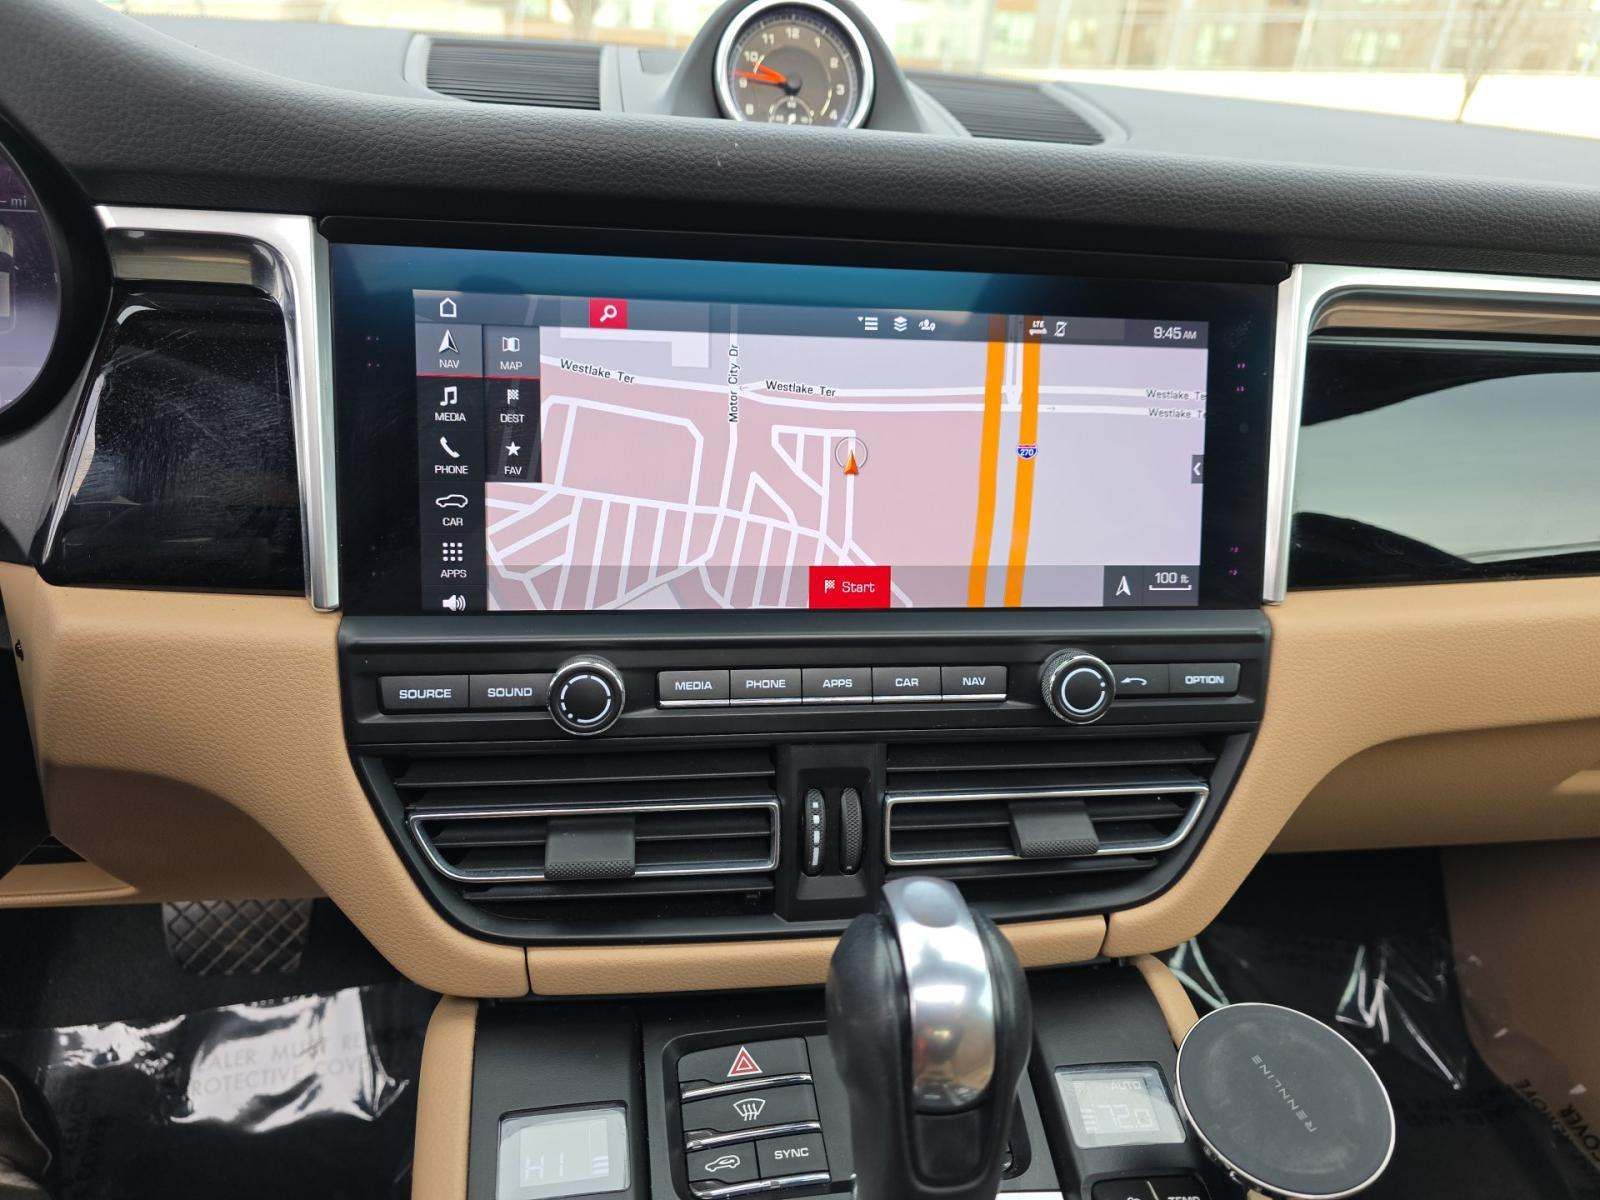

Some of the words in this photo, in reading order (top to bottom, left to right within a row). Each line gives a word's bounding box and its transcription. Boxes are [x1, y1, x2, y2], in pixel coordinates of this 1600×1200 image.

[762, 34, 775, 45] 11
[11, 195, 27, 208] mi
[1032, 320, 1045, 328] LTE
[1153, 326, 1182, 340] 9:45
[1182, 330, 1198, 340] AM
[728, 344, 739, 357] Dr
[439, 359, 460, 369] NAV
[500, 361, 523, 370] MAP
[560, 358, 611, 378] Westlake
[618, 371, 635, 384] Ter
[728, 363, 740, 385] City
[766, 380, 814, 394] Westlake
[820, 386, 836, 396] Ter
[1146, 389, 1190, 400] Westlake
[728, 391, 738, 423] Motor
[1148, 408, 1192, 418] Westlake
[434, 412, 467, 422] MEDIA
[500, 414, 525, 424] DEST
[434, 465, 469, 475] PHONE
[504, 466, 522, 476] FAV
[442, 517, 464, 526] CAR
[440, 569, 468, 578] APPS
[1154, 572, 1178, 584] 100
[842, 581, 876, 593] Start
[674, 680, 713, 691] MEDIA
[745, 678, 787, 690] PHONE
[822, 678, 853, 690] APPS
[895, 676, 919, 688] CAR
[962, 676, 986, 687] NAV
[1184, 674, 1225, 685] OPTION
[398, 688, 452, 700] SOURCE
[487, 686, 533, 698] SOUND
[1251, 1054, 1318, 1133] RENNLINE
[774, 1147, 810, 1160] SYNC
